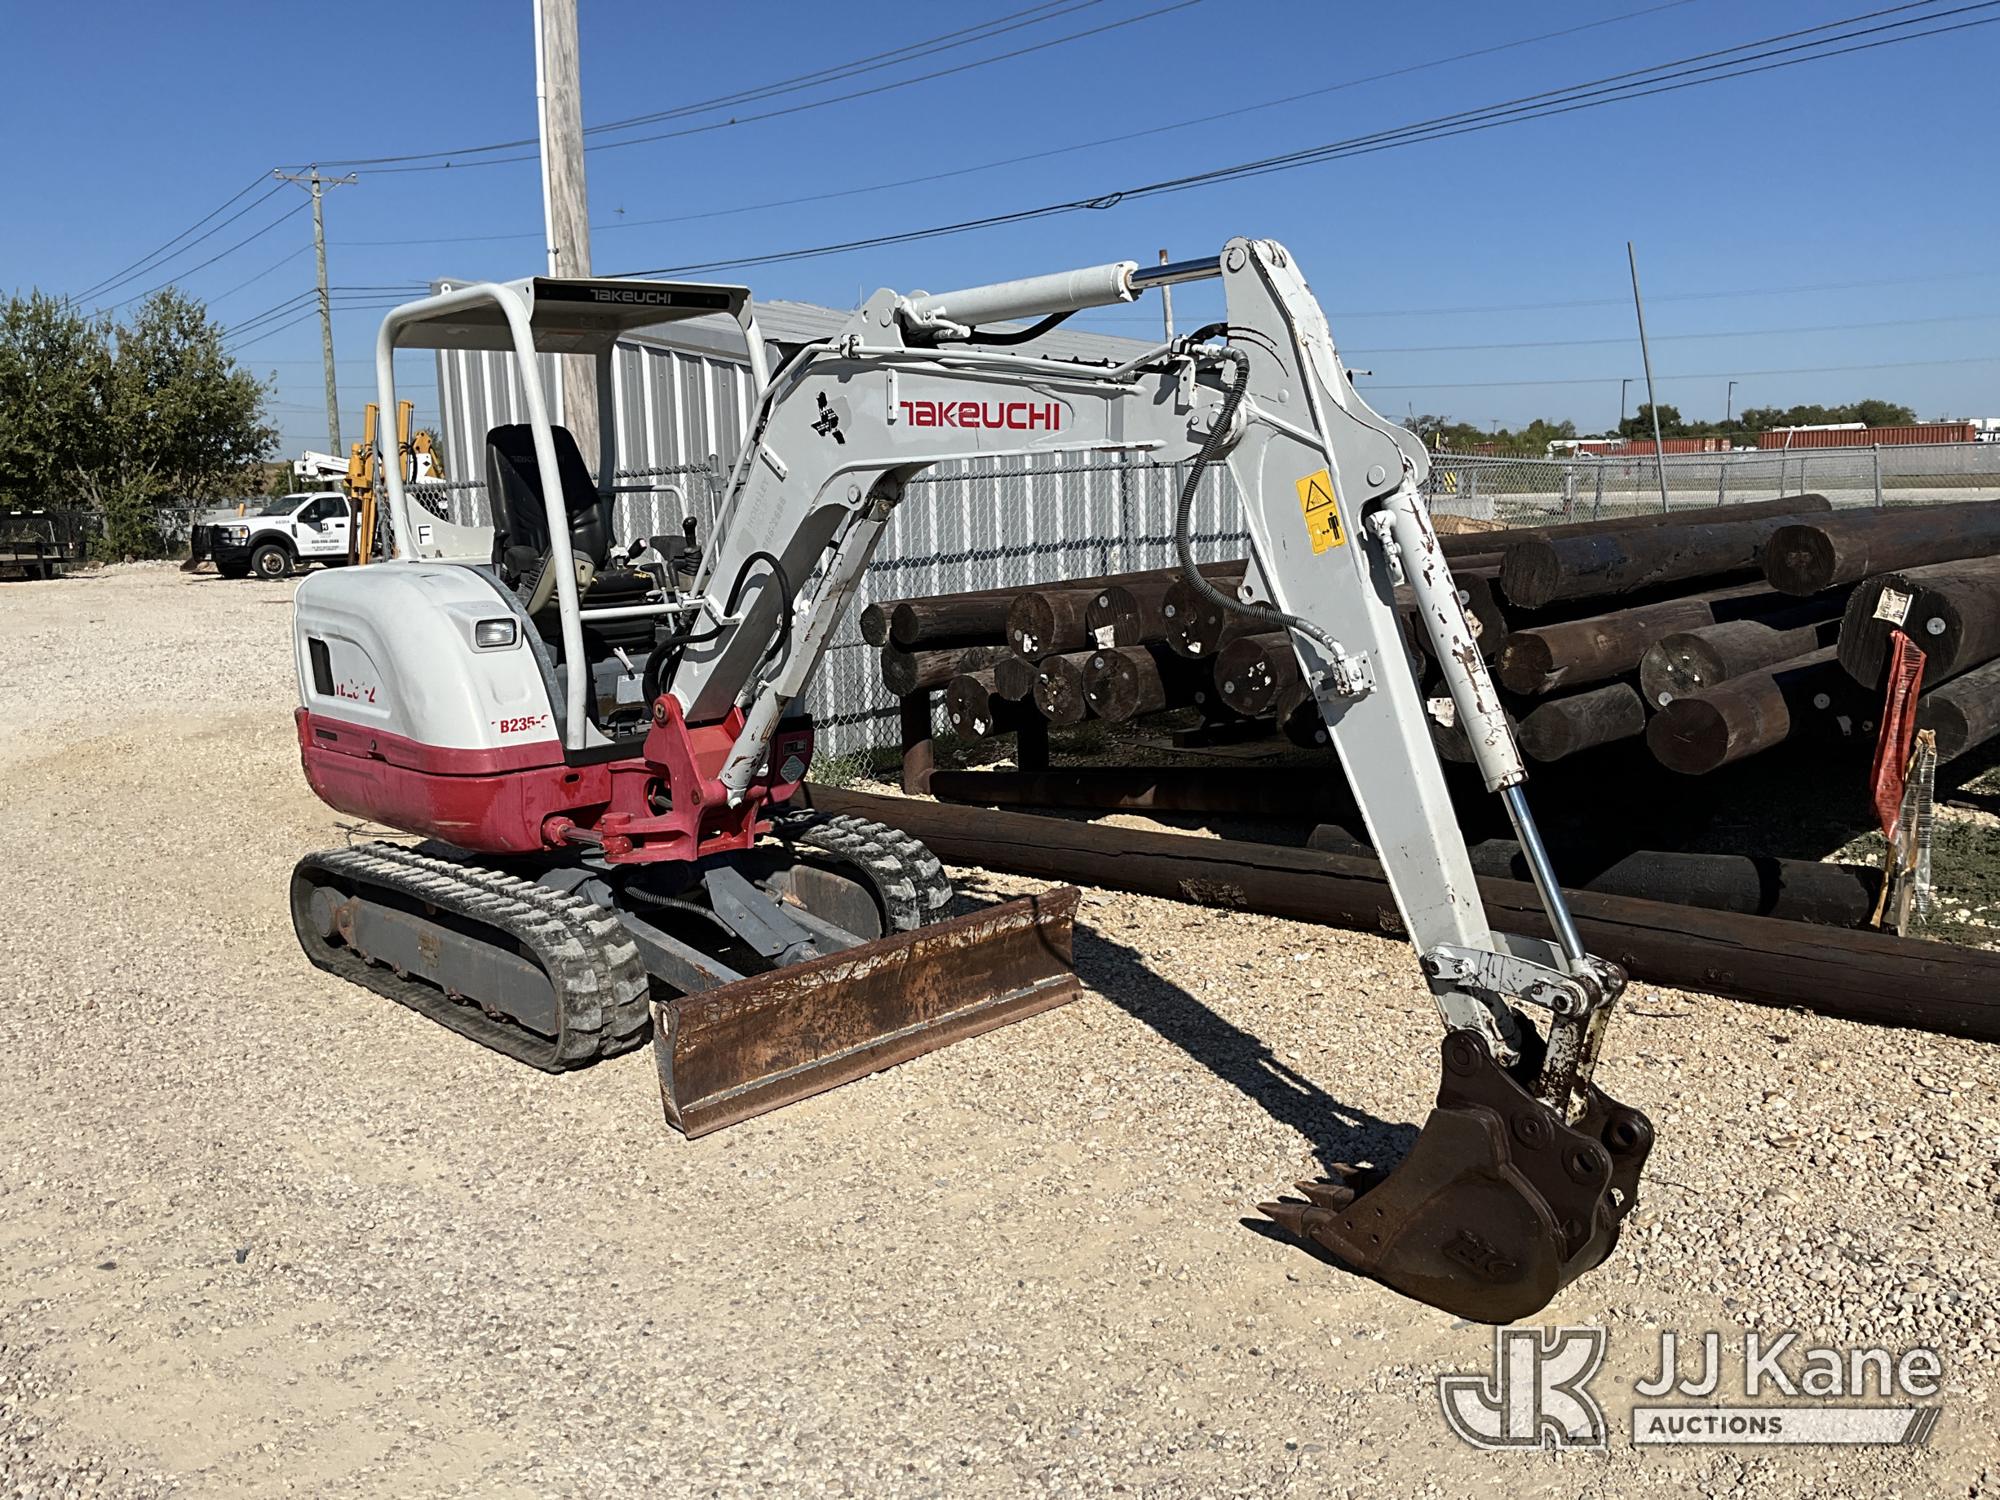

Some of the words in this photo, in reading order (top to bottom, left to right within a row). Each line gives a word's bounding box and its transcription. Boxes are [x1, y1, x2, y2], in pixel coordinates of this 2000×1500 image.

[590, 289, 671, 305] TAKEUCHI
[899, 401, 1060, 430] TAKEUCHI
[418, 525, 431, 544] F
